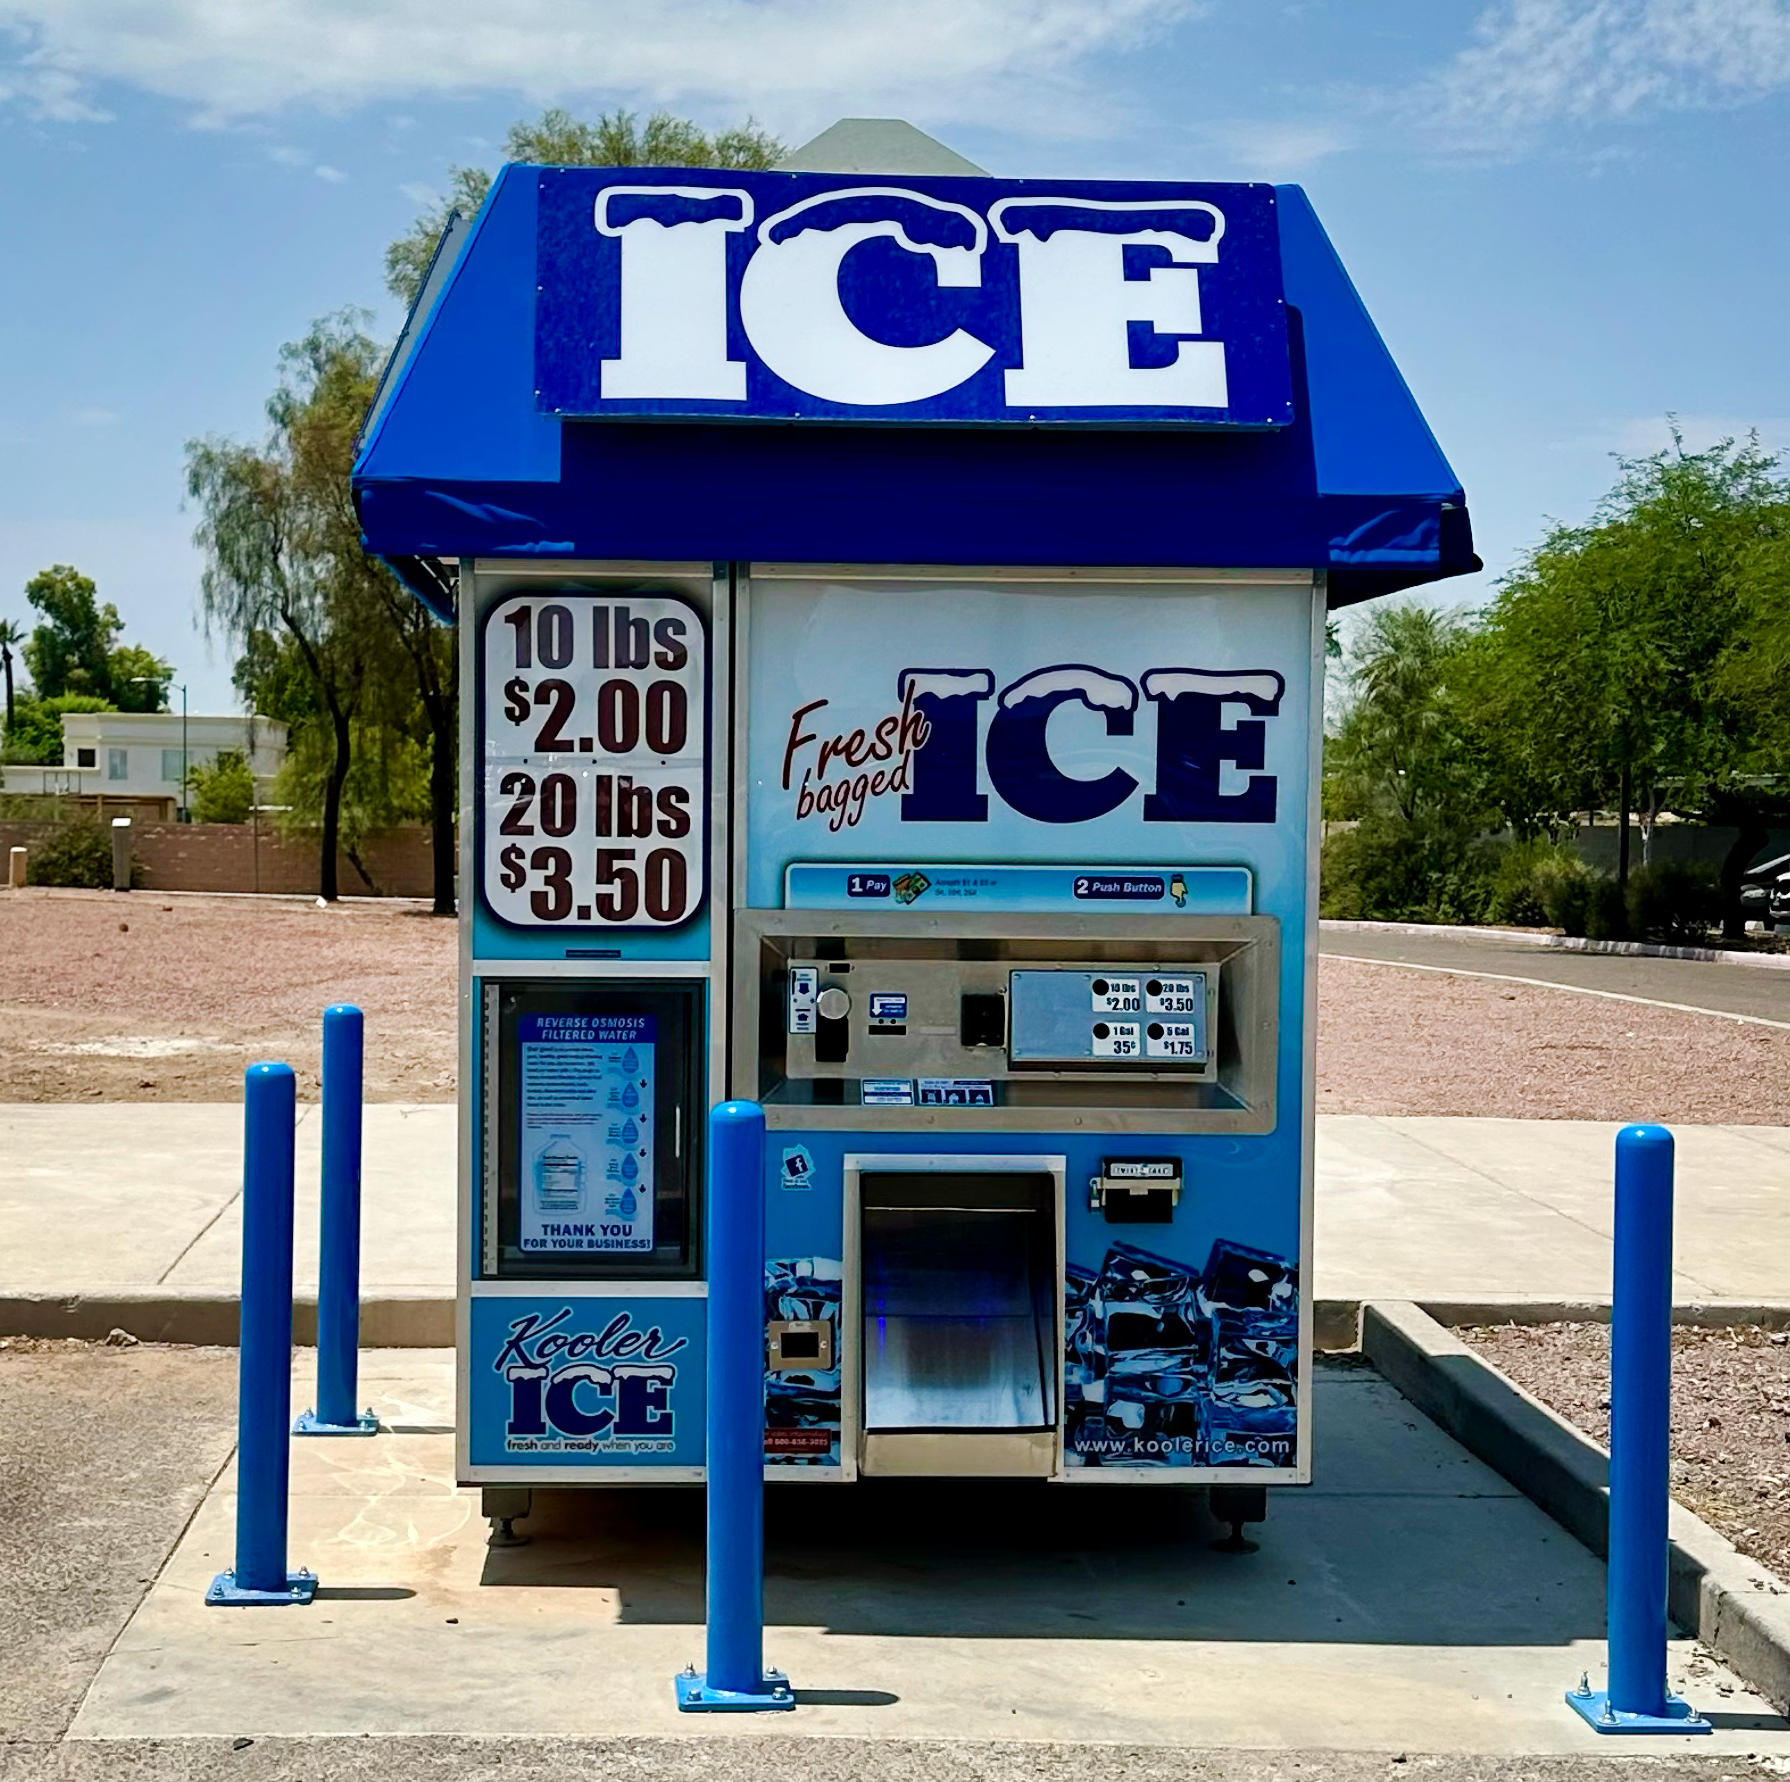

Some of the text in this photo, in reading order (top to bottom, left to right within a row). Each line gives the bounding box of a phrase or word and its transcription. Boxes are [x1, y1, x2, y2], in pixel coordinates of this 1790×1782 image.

[595, 186, 1228, 407] ICE
[504, 605, 688, 671] 10 lbs
[504, 676, 687, 754] $2.00
[782, 679, 930, 790] Fresh
[898, 664, 1285, 823] ICE
[796, 749, 911, 832] bagged
[500, 772, 691, 838] 20 lbs
[500, 843, 687, 922] $3.50
[851, 877, 887, 892] 1 Pay
[1077, 879, 1162, 894] 2 Push Button
[1110, 984, 1136, 993] 10 lbs
[1163, 984, 1189, 993] 20 lbs
[1106, 997, 1140, 1011] $2.00
[1160, 997, 1193, 1011] $3.50
[537, 1018, 645, 1028] REVERSE OSMOSIS
[542, 1030, 637, 1040] FILTERED WATER
[1164, 1041, 1193, 1054] $1.75
[541, 1224, 632, 1236] THANK YOU
[524, 1239, 651, 1249] FOR YOUR BUSINESS!
[494, 1308, 687, 1371] Kooler
[507, 1363, 676, 1436] ICE
[507, 1439, 673, 1454] fresh and ready when you are
[1074, 1437, 1290, 1453] www.koolerice.com
